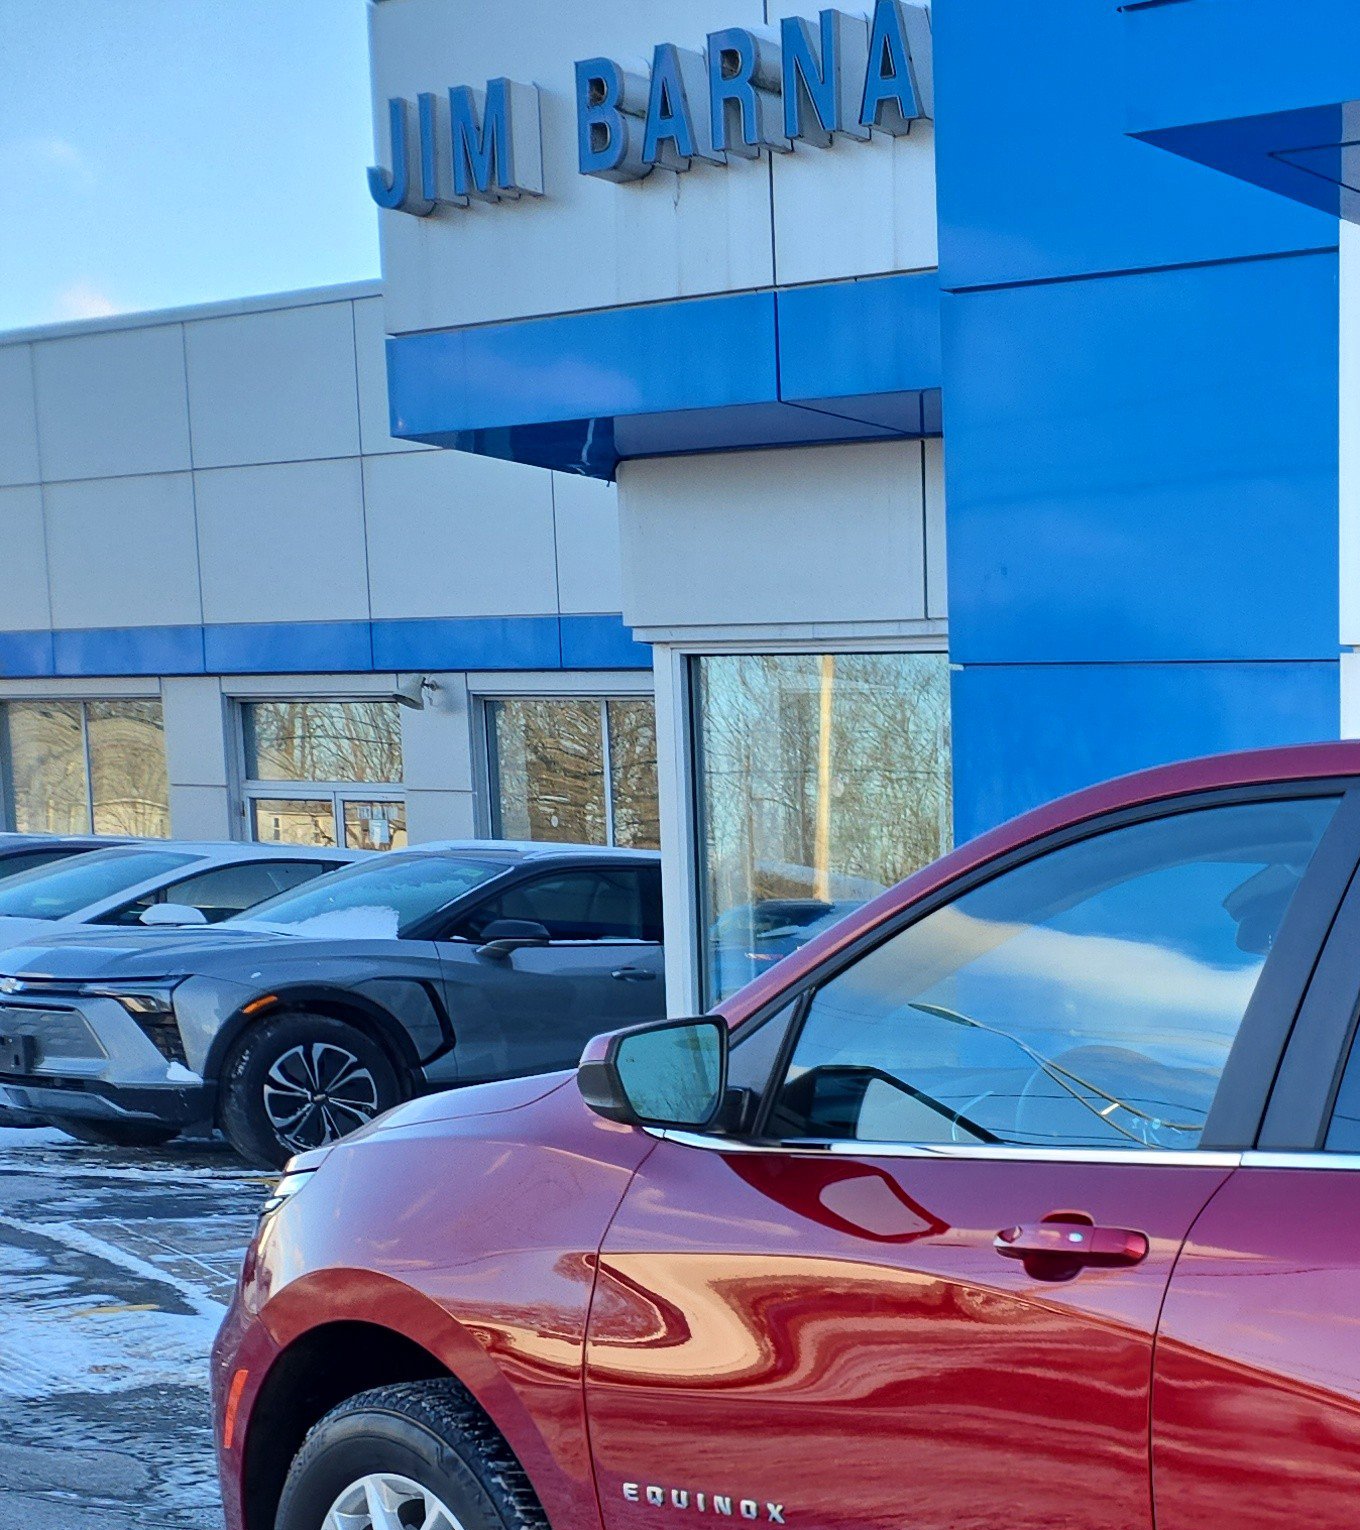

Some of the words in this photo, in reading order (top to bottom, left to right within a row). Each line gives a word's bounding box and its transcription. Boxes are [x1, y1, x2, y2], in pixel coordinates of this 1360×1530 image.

[366, 76, 518, 211] JIM
[573, 0, 928, 178] BARNA
[622, 1482, 786, 1524] EQUINOX
